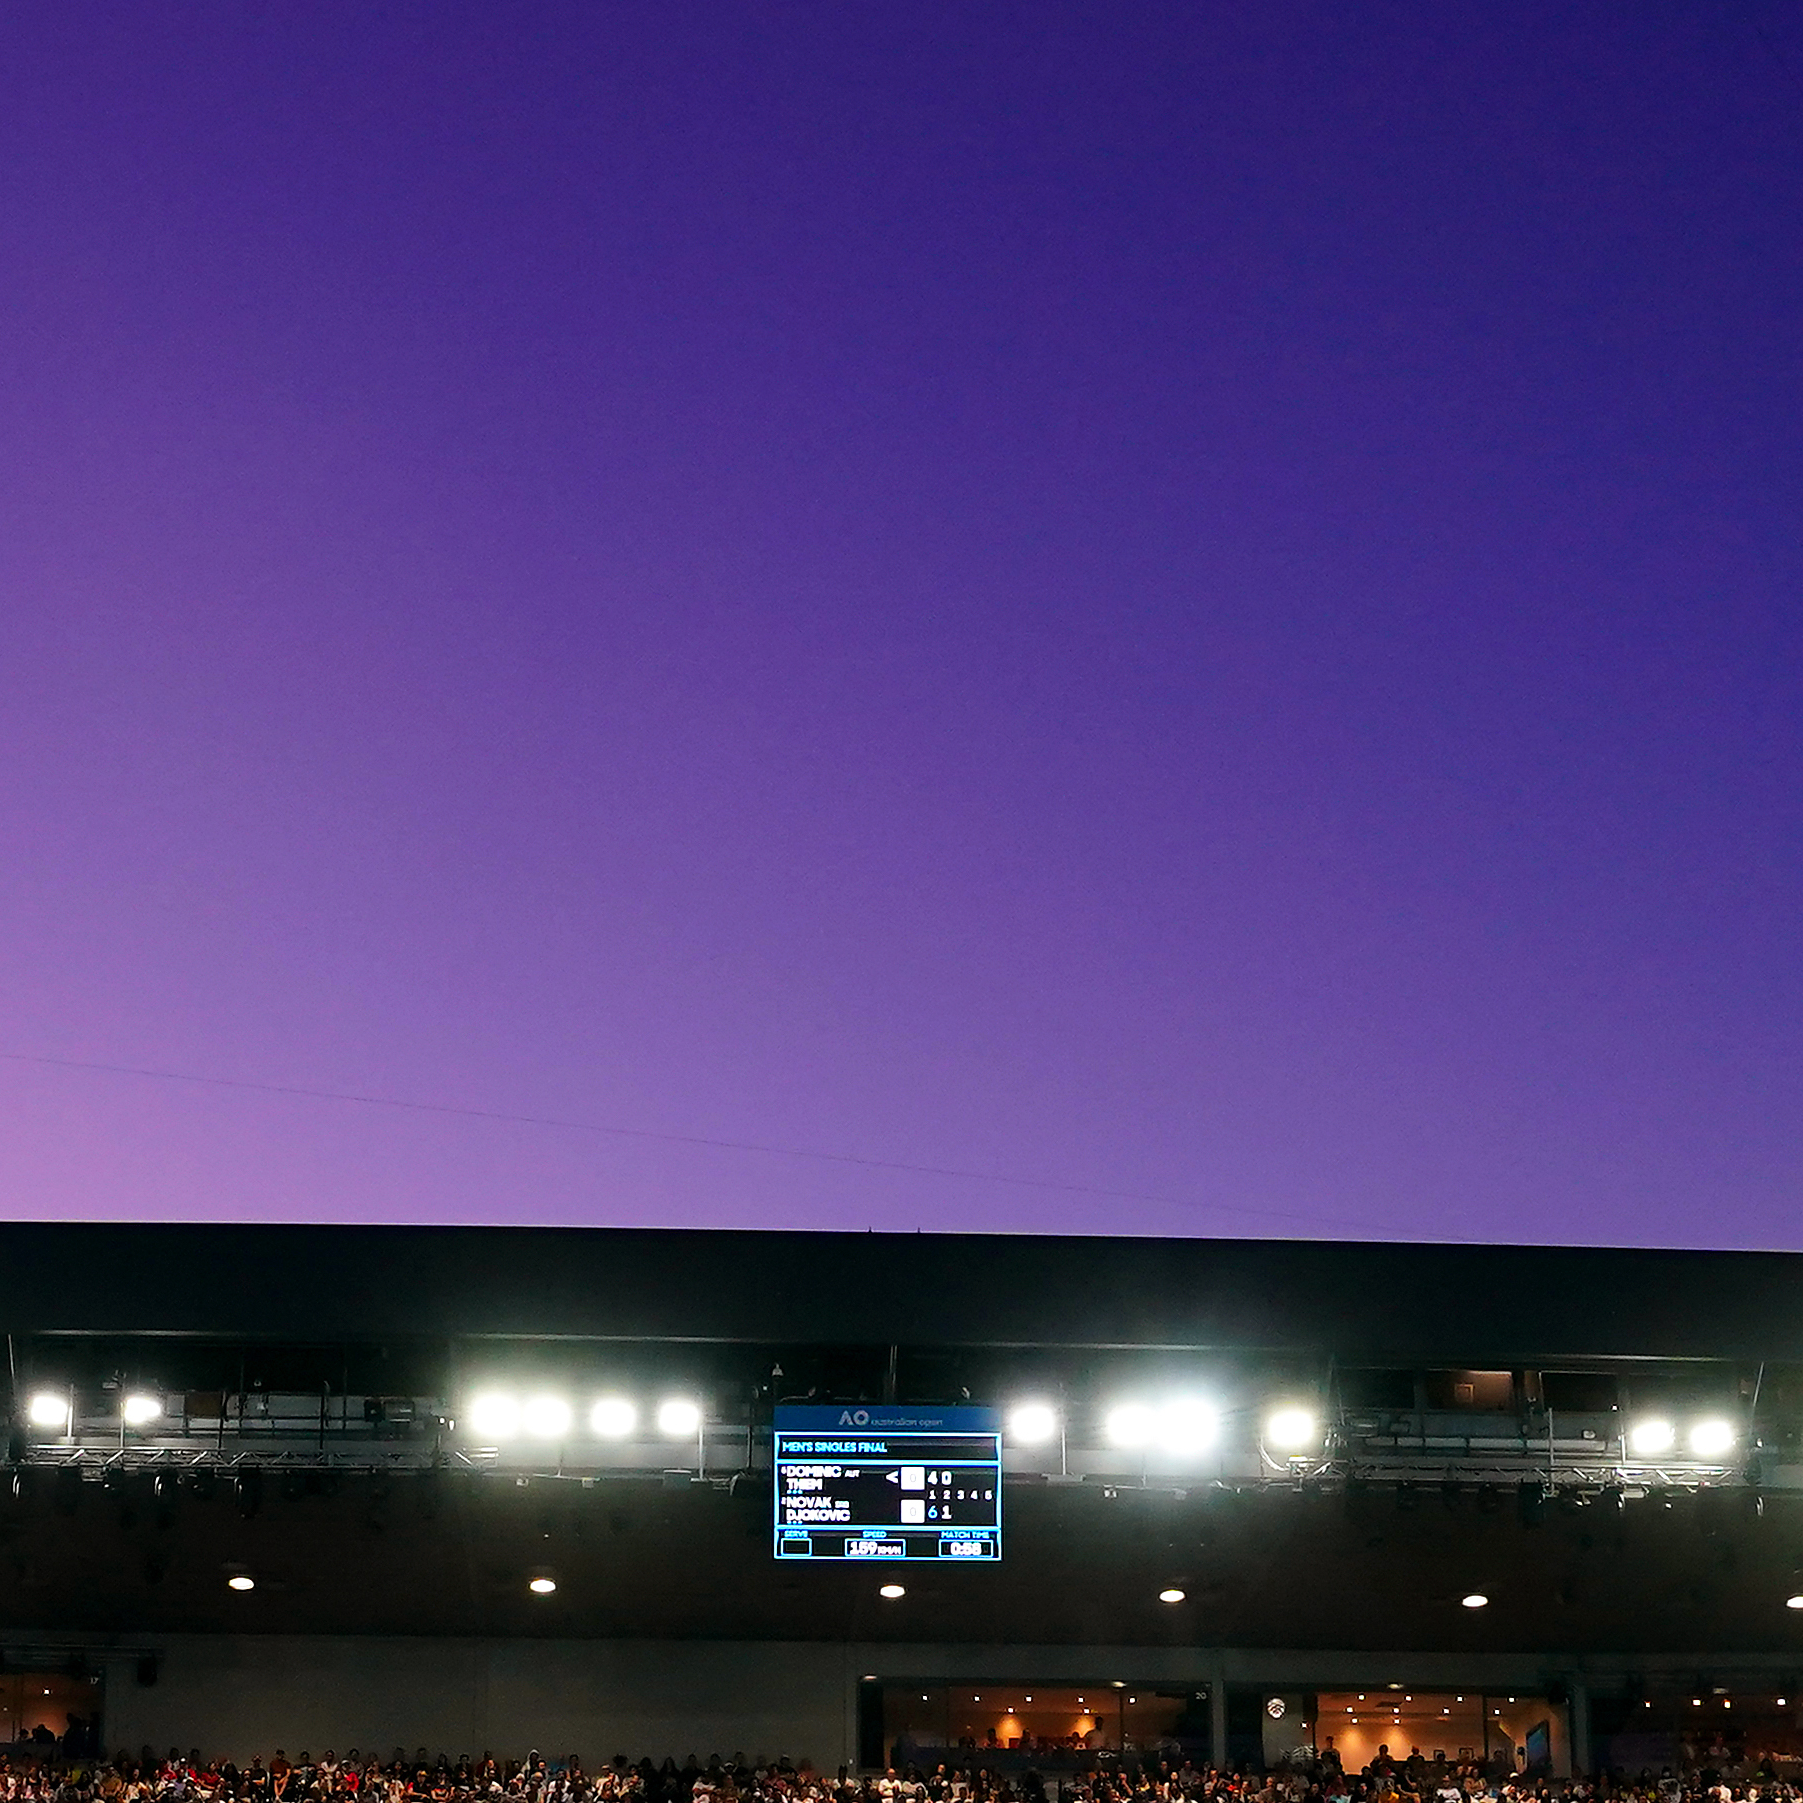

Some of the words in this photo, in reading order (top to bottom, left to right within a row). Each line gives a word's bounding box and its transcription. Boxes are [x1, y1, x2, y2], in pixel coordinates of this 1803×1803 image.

[838, 1410, 869, 1426] AO
[871, 1418, 917, 1426] australian
[919, 1419, 943, 1427] open
[814, 1441, 857, 1453] SINGLES
[857, 1442, 887, 1453] FINAL
[786, 1466, 841, 1478] DOMINIC
[928, 1471, 938, 1485] 4
[941, 1471, 952, 1485] 0
[909, 1474, 917, 1483] 0
[929, 1490, 937, 1500] 1
[943, 1490, 951, 1500] 2
[957, 1490, 964, 1500] 3
[970, 1490, 978, 1500] 4
[984, 1490, 992, 1500] 5
[786, 1497, 832, 1509] NOVAK
[786, 1509, 850, 1521] DJOKOVIC
[909, 1507, 917, 1516] 0
[928, 1506, 938, 1519] 6
[942, 1506, 952, 1519] 1
[941, 1531, 971, 1539] MATCH
